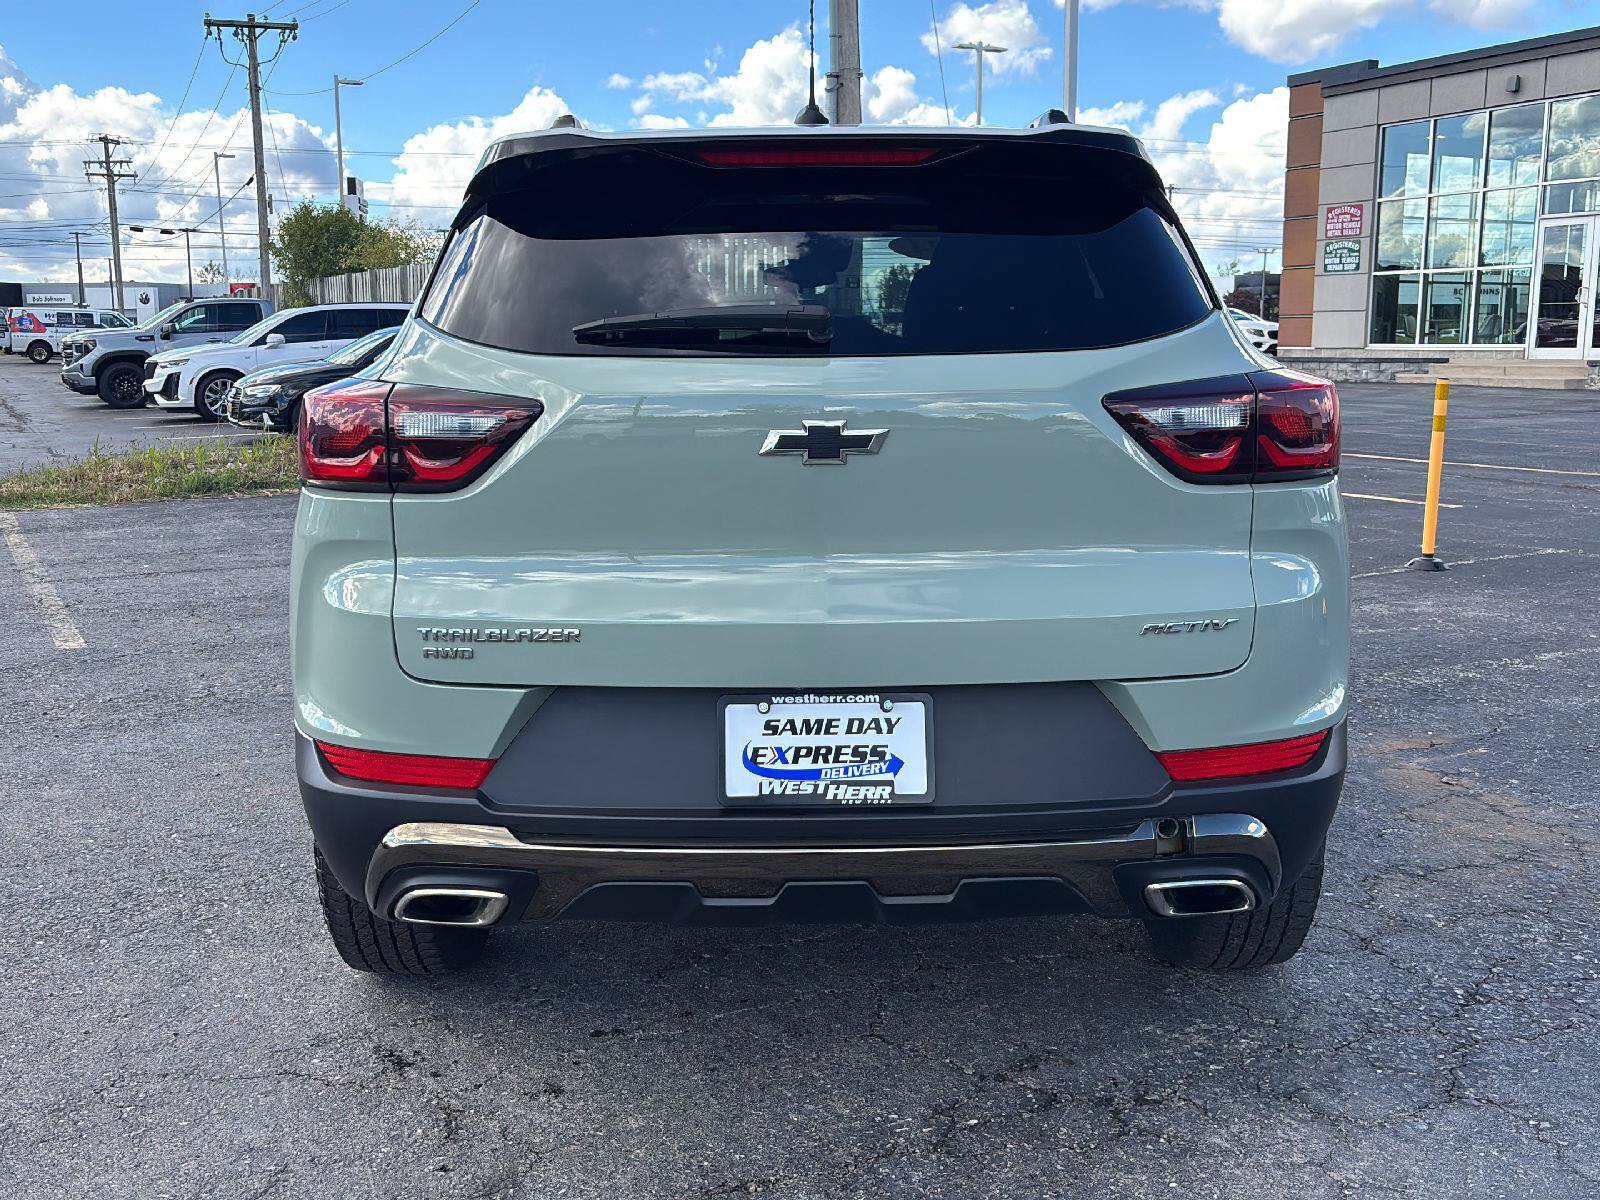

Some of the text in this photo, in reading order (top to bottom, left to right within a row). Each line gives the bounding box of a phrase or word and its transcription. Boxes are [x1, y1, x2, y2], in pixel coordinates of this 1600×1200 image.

[1327, 206, 1361, 218] REGISTERED
[1326, 241, 1360, 253] REGISTERED
[1139, 617, 1239, 635] ACTIV
[416, 627, 581, 643] TRAILBLAZER
[422, 647, 474, 660] AWD
[771, 694, 880, 704] westherr.com
[761, 717, 902, 736] SAME DAY
[751, 745, 889, 765] EXPRESS
[820, 761, 890, 779] DELIVERY
